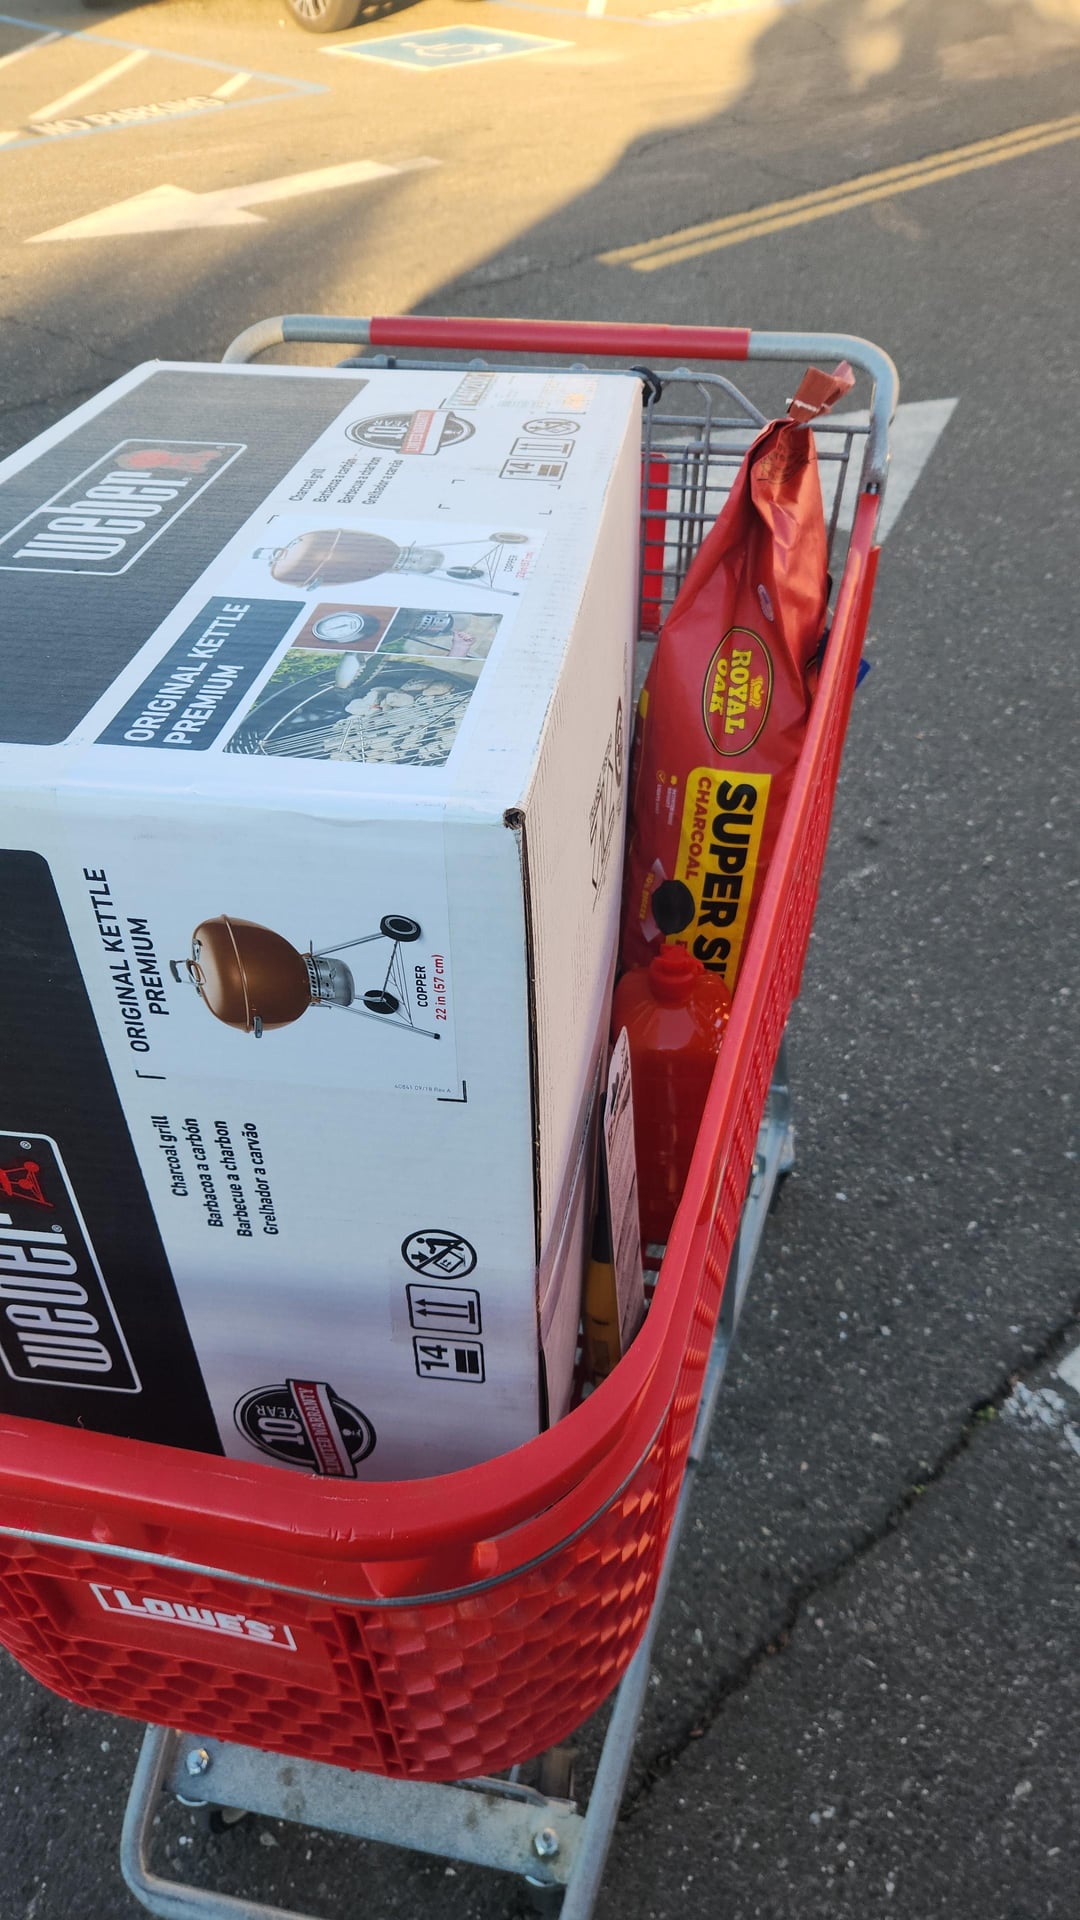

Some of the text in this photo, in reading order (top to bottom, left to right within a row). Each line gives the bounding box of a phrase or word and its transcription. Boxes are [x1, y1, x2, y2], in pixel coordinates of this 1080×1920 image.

[30, 96, 225, 135] NO PARKING
[364, 425, 407, 440] 10
[288, 479, 318, 501] Charcoal
[313, 479, 342, 502] Barbacoa
[337, 480, 366, 503] Barbecue
[507, 462, 535, 475] 14
[124, 603, 250, 741] ORIGINAL KETTLE
[709, 658, 728, 716] OAK
[725, 649, 752, 734] ROYAL
[163, 664, 245, 745] PREMIUM
[685, 776, 712, 880] CHARCOAL
[697, 780, 757, 928] SUPER
[83, 867, 151, 1052] ORIGINAL KETTLE
[127, 917, 170, 1015] PREMIUM
[415, 965, 428, 1008] COPPER
[431, 954, 447, 1021] 22 in (57 cm)
[151, 1115, 188, 1197] Charcoal grill
[182, 1118, 224, 1227] Barbacoa a carbón
[214, 1120, 253, 1237] Barbecue a charbon
[241, 1122, 279, 1235] Grelhador a carvão
[419, 1344, 449, 1371] 14
[255, 1404, 299, 1419] YEAR
[258, 1417, 304, 1446] 10
[298, 1387, 328, 1436] WARRANTY
